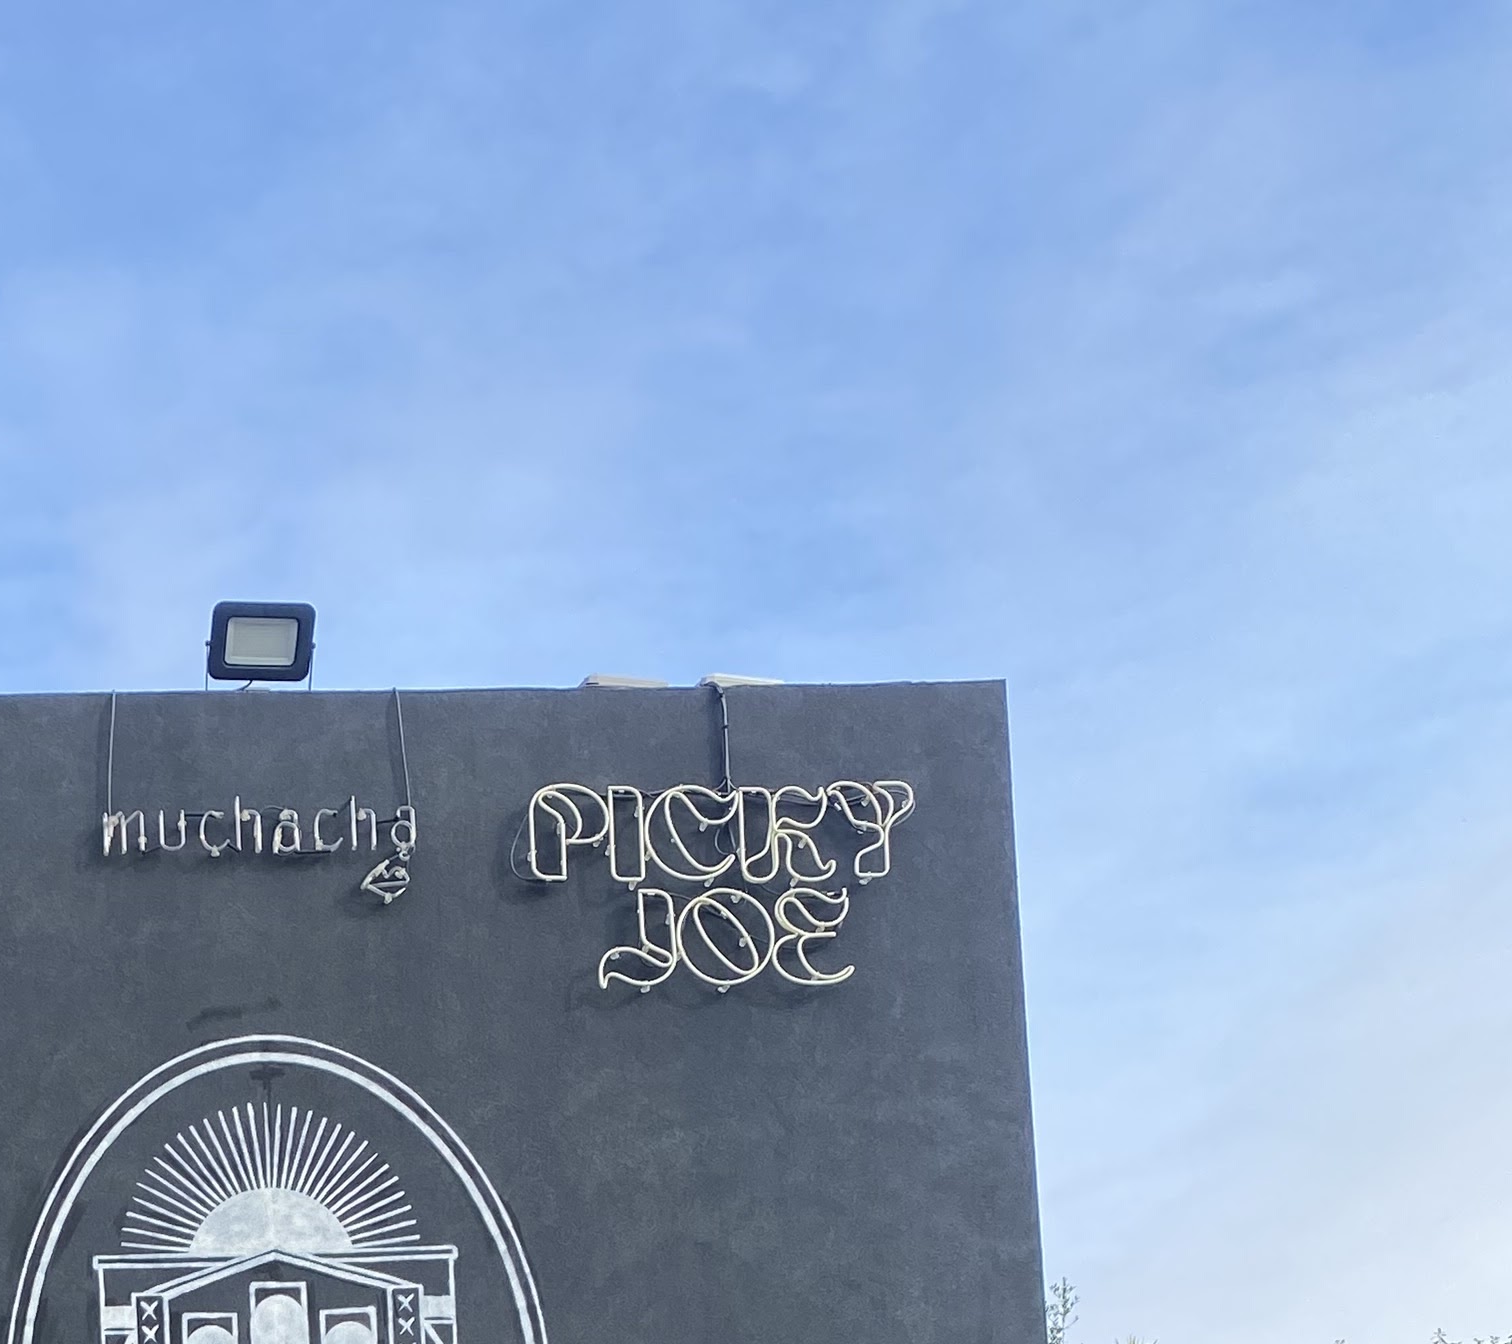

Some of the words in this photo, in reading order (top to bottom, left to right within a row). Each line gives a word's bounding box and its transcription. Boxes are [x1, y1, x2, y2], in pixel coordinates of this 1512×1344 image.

[103, 795, 417, 856] muchacha
[528, 780, 916, 885] PICKY
[599, 886, 855, 991] JOE
